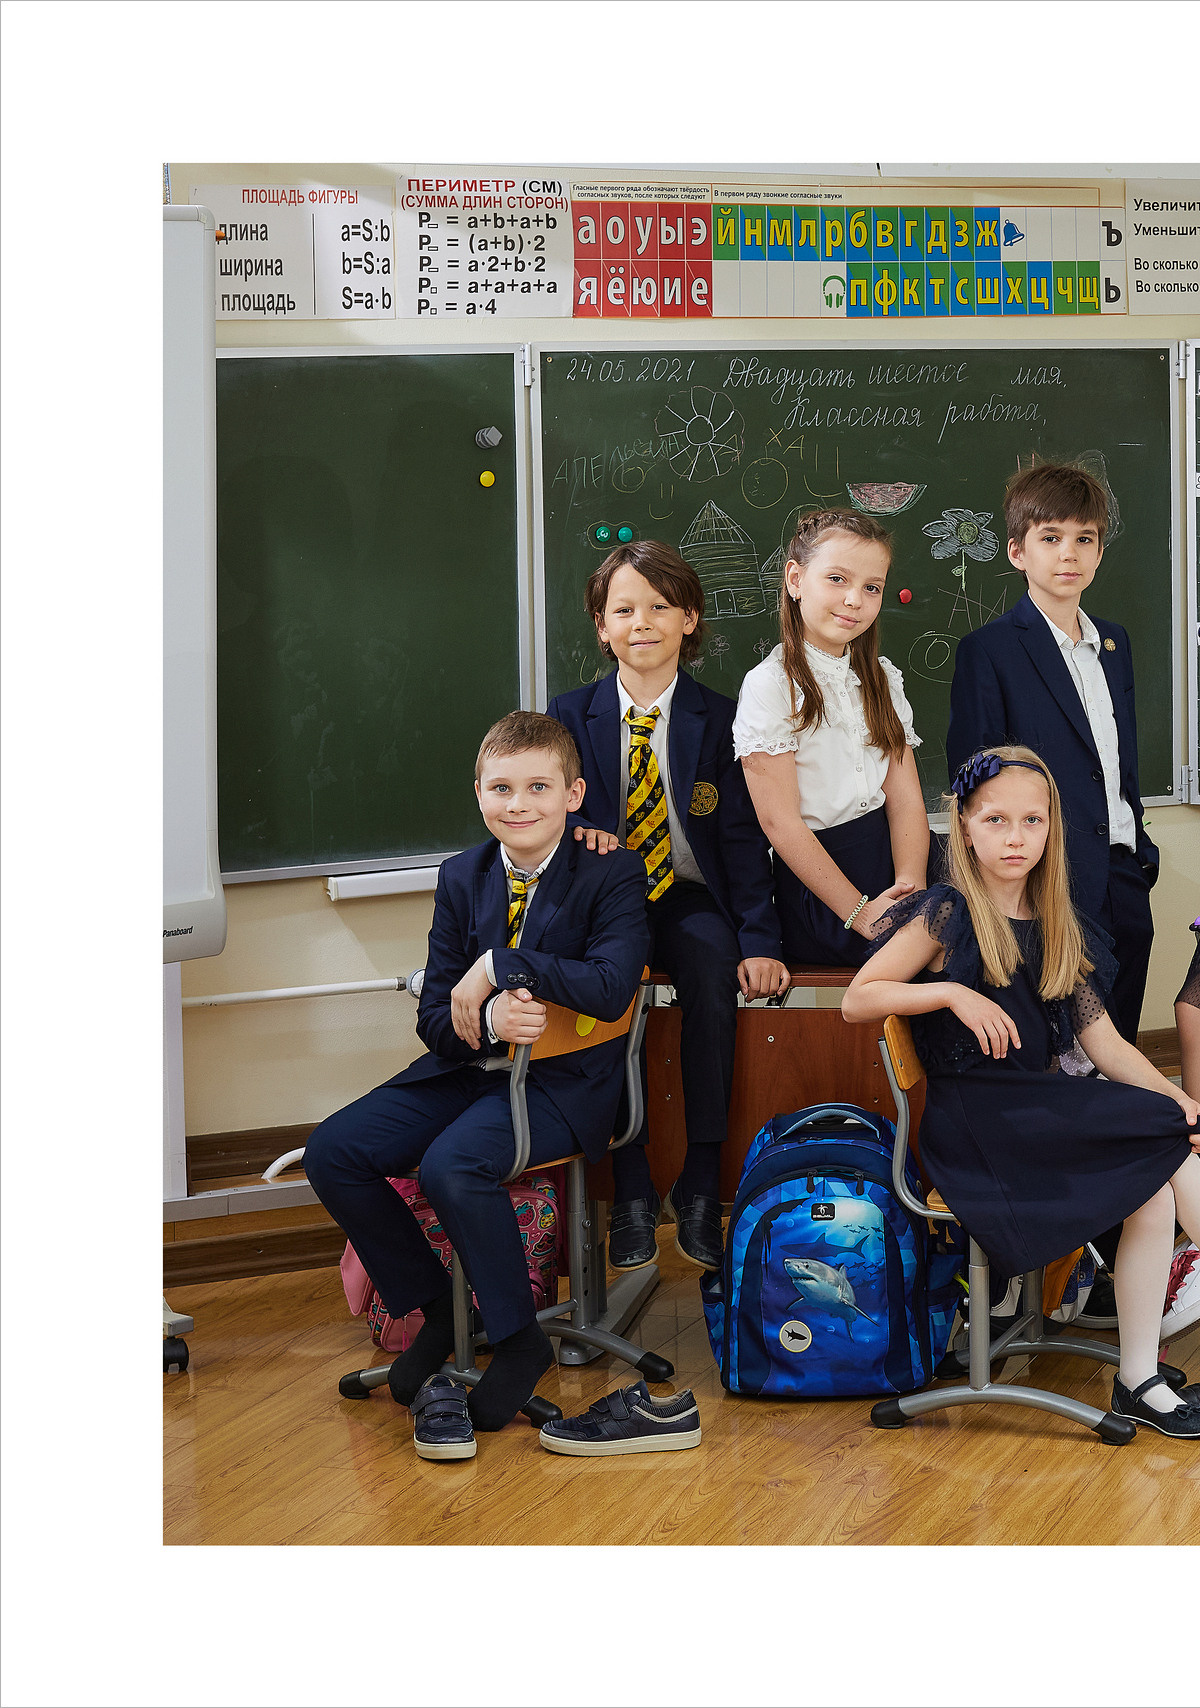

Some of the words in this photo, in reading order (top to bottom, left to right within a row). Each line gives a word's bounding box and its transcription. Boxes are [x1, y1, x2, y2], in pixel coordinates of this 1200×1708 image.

[242, 186, 305, 205] ПЛОЩАДЬ
[308, 186, 359, 205] ФИГУРЫ
[407, 177, 516, 194] ПЕРИМЕТР
[522, 178, 563, 195] (СМ)
[401, 193, 460, 210] (СУММА
[461, 193, 503, 210] ДЛИН
[506, 193, 569, 212] СТОРОН)
[341, 219, 391, 243] a=S:b
[467, 210, 558, 229] a+b+a+b
[216, 220, 269, 245] длина
[577, 216, 597, 245] а
[606, 215, 625, 245] о
[635, 216, 654, 255] у
[660, 217, 683, 245] ы
[691, 217, 707, 245] э
[219, 257, 284, 281] ширина
[342, 250, 391, 276] b=S:a
[1134, 257, 1149, 271] Во
[1152, 259, 1199, 272] сколько
[467, 277, 558, 293] a+a+a+a
[577, 277, 597, 305] я
[607, 266, 627, 305] ё
[632, 277, 659, 305] ю
[664, 278, 682, 305] и
[690, 278, 708, 305] е
[1136, 280, 1150, 293] Во
[1154, 281, 1199, 293] сколько
[221, 290, 296, 316] площадь
[566, 357, 696, 383] 24.05.2021
[722, 357, 855, 403] Двадцать
[783, 398, 925, 431] Классная
